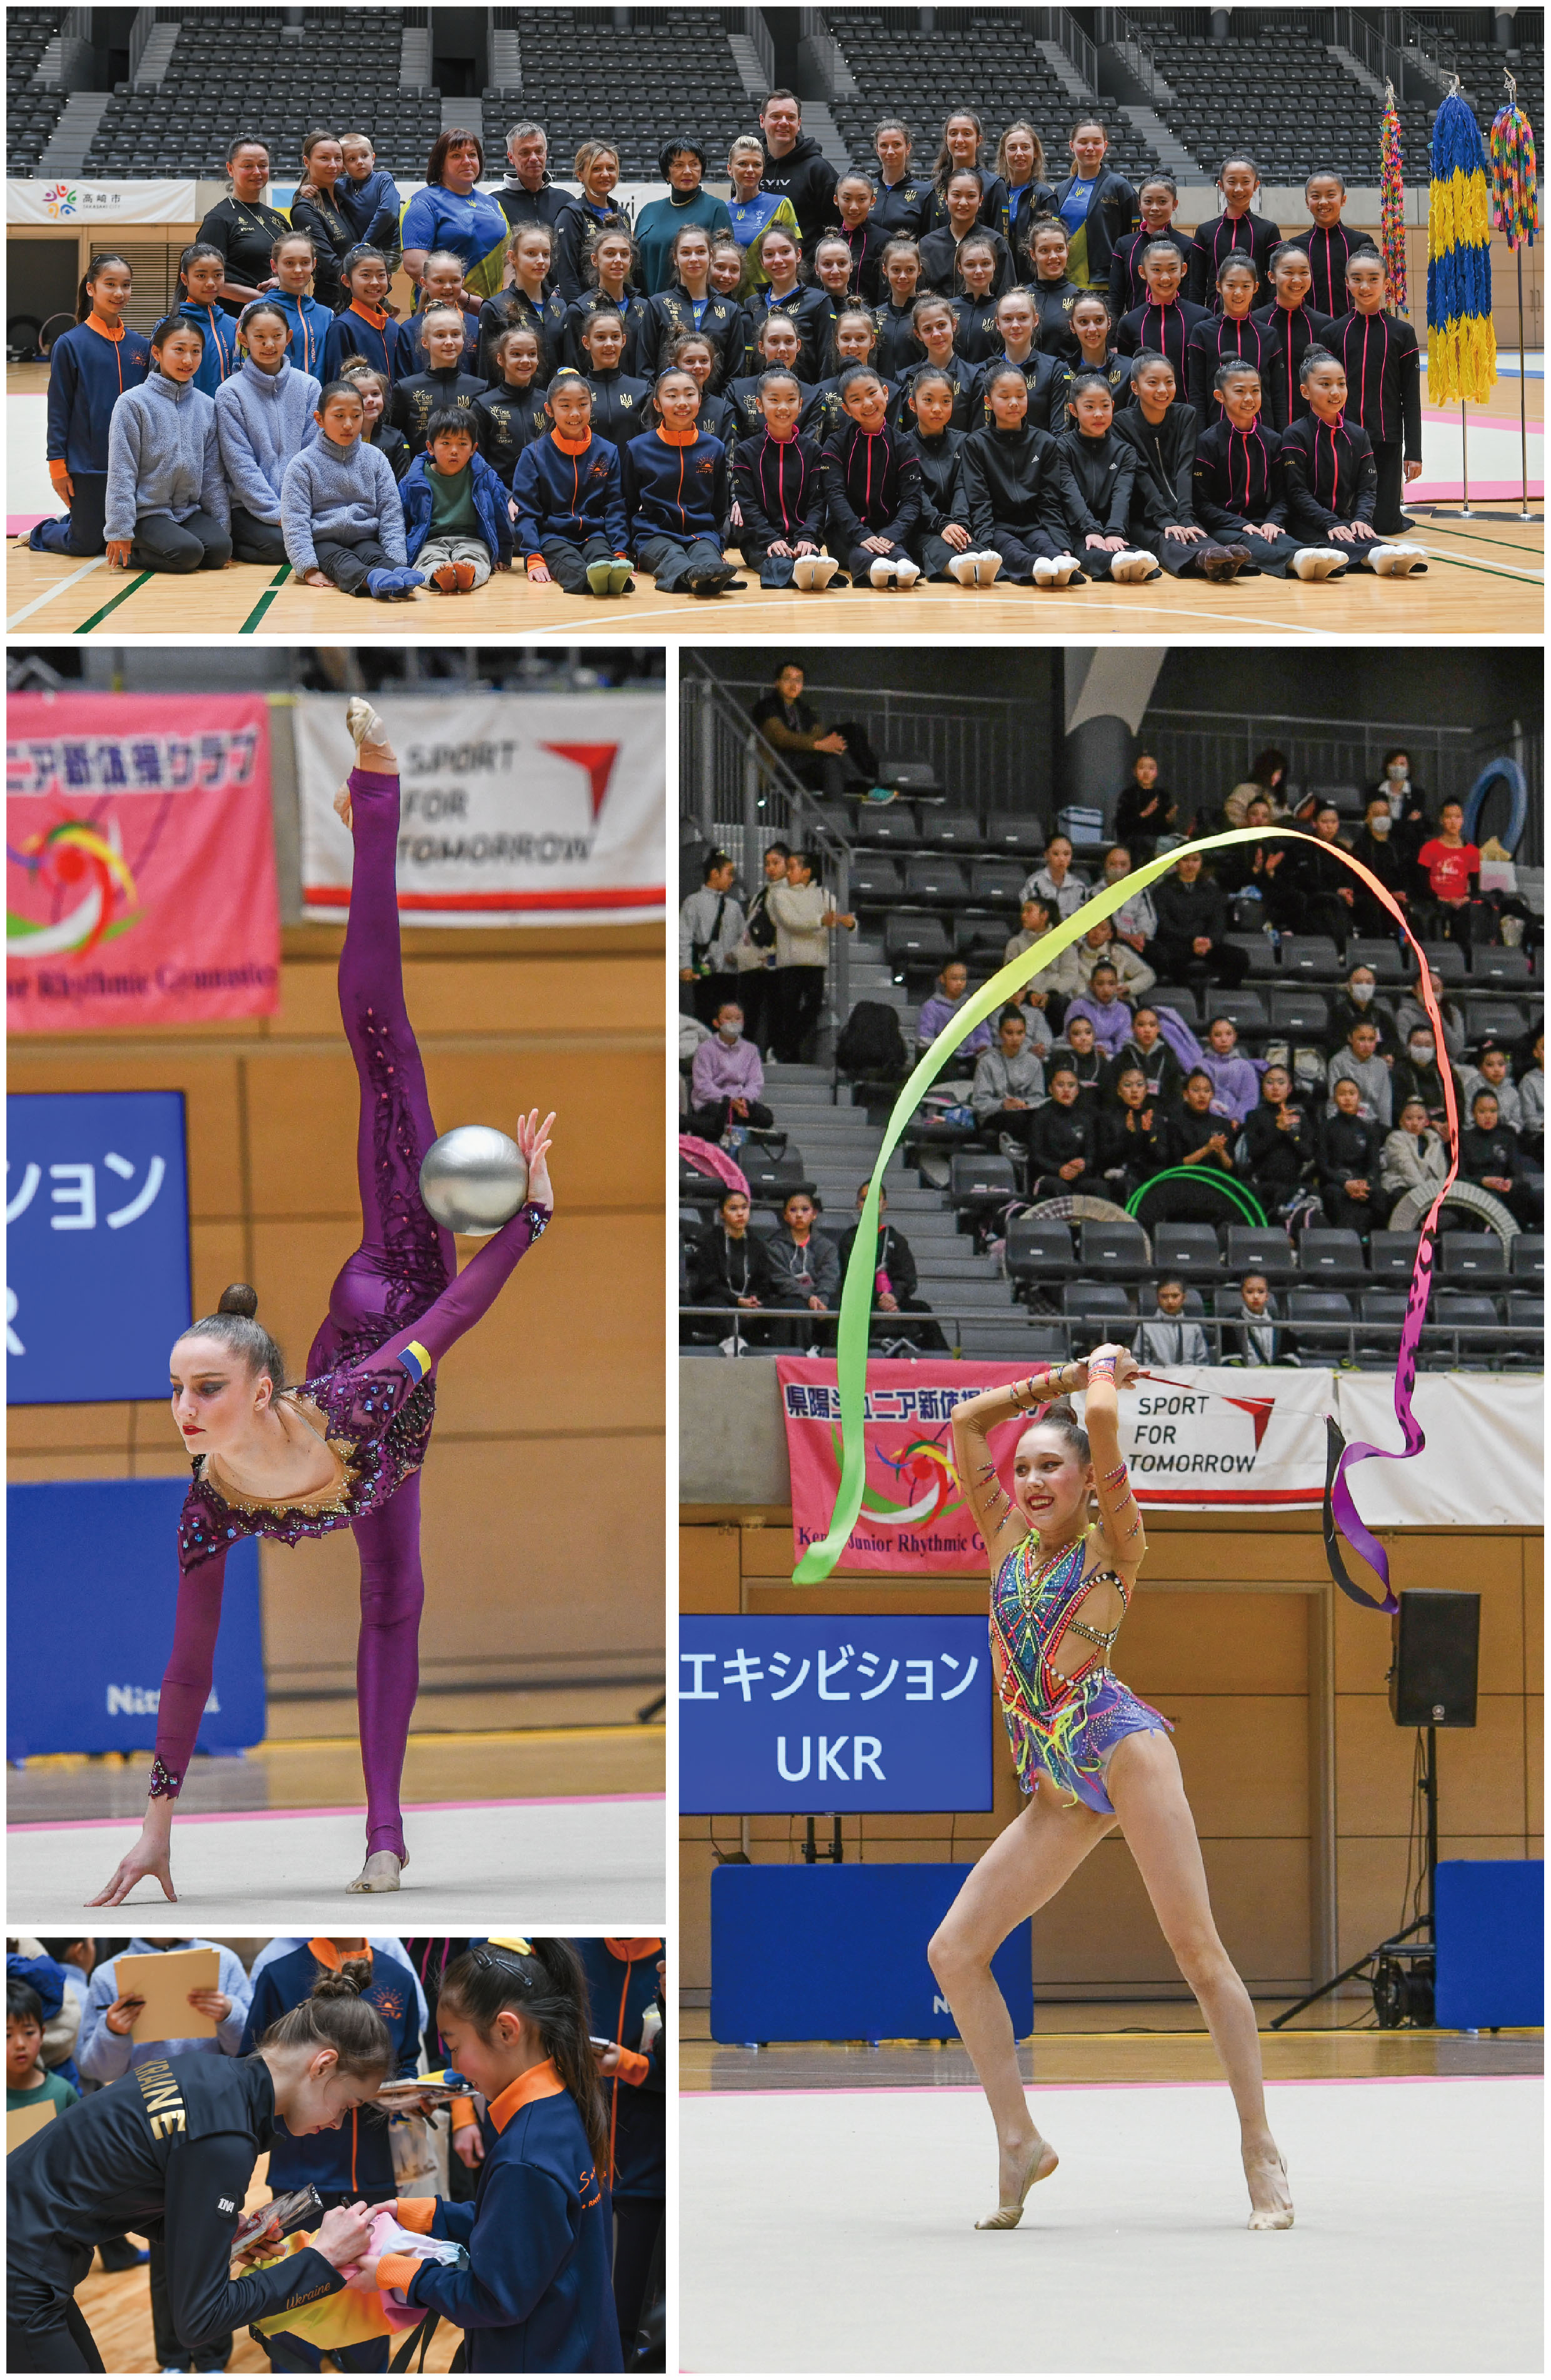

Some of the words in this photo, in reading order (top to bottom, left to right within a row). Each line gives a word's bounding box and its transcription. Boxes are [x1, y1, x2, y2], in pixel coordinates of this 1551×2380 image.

[83, 194, 121, 203] 高崎市
[405, 740, 517, 774] SPORT
[404, 788, 469, 821] FOR
[399, 831, 593, 866] TOMORROW
[1138, 1396, 1210, 1415] SPORT
[1134, 1425, 1177, 1445] FOR
[1128, 1454, 1256, 1473] TOMORROW
[898, 1534, 967, 1557] Rhythmic
[679, 1644, 979, 1702] エキシビション
[777, 1735, 886, 1782] UKR
[133, 2057, 186, 2140] KRAINE
[286, 2282, 331, 2310] Ukraine
